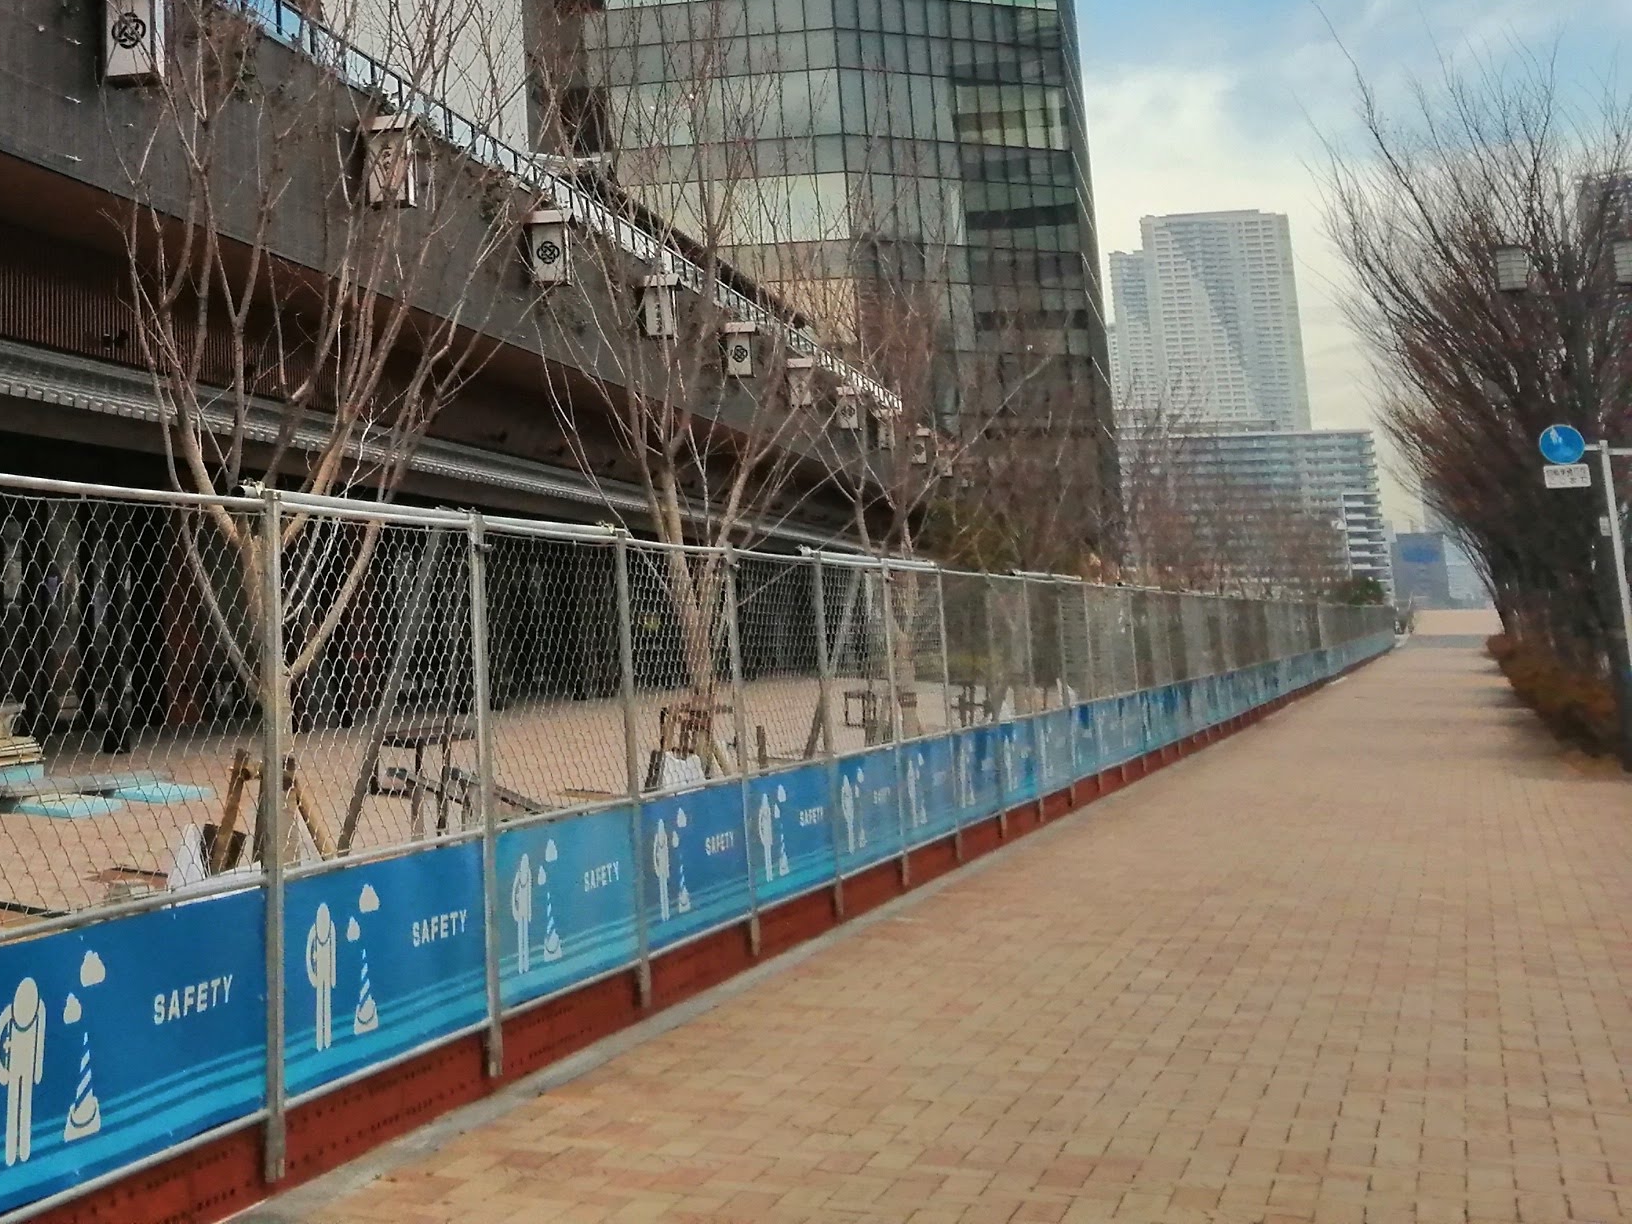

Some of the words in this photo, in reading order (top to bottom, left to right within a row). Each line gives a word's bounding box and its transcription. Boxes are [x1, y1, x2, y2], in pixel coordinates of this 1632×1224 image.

[705, 829, 736, 857] SAFETY
[583, 860, 620, 893] SAFETY
[412, 909, 468, 948] SAFETY
[152, 973, 235, 1027] SAFETY
